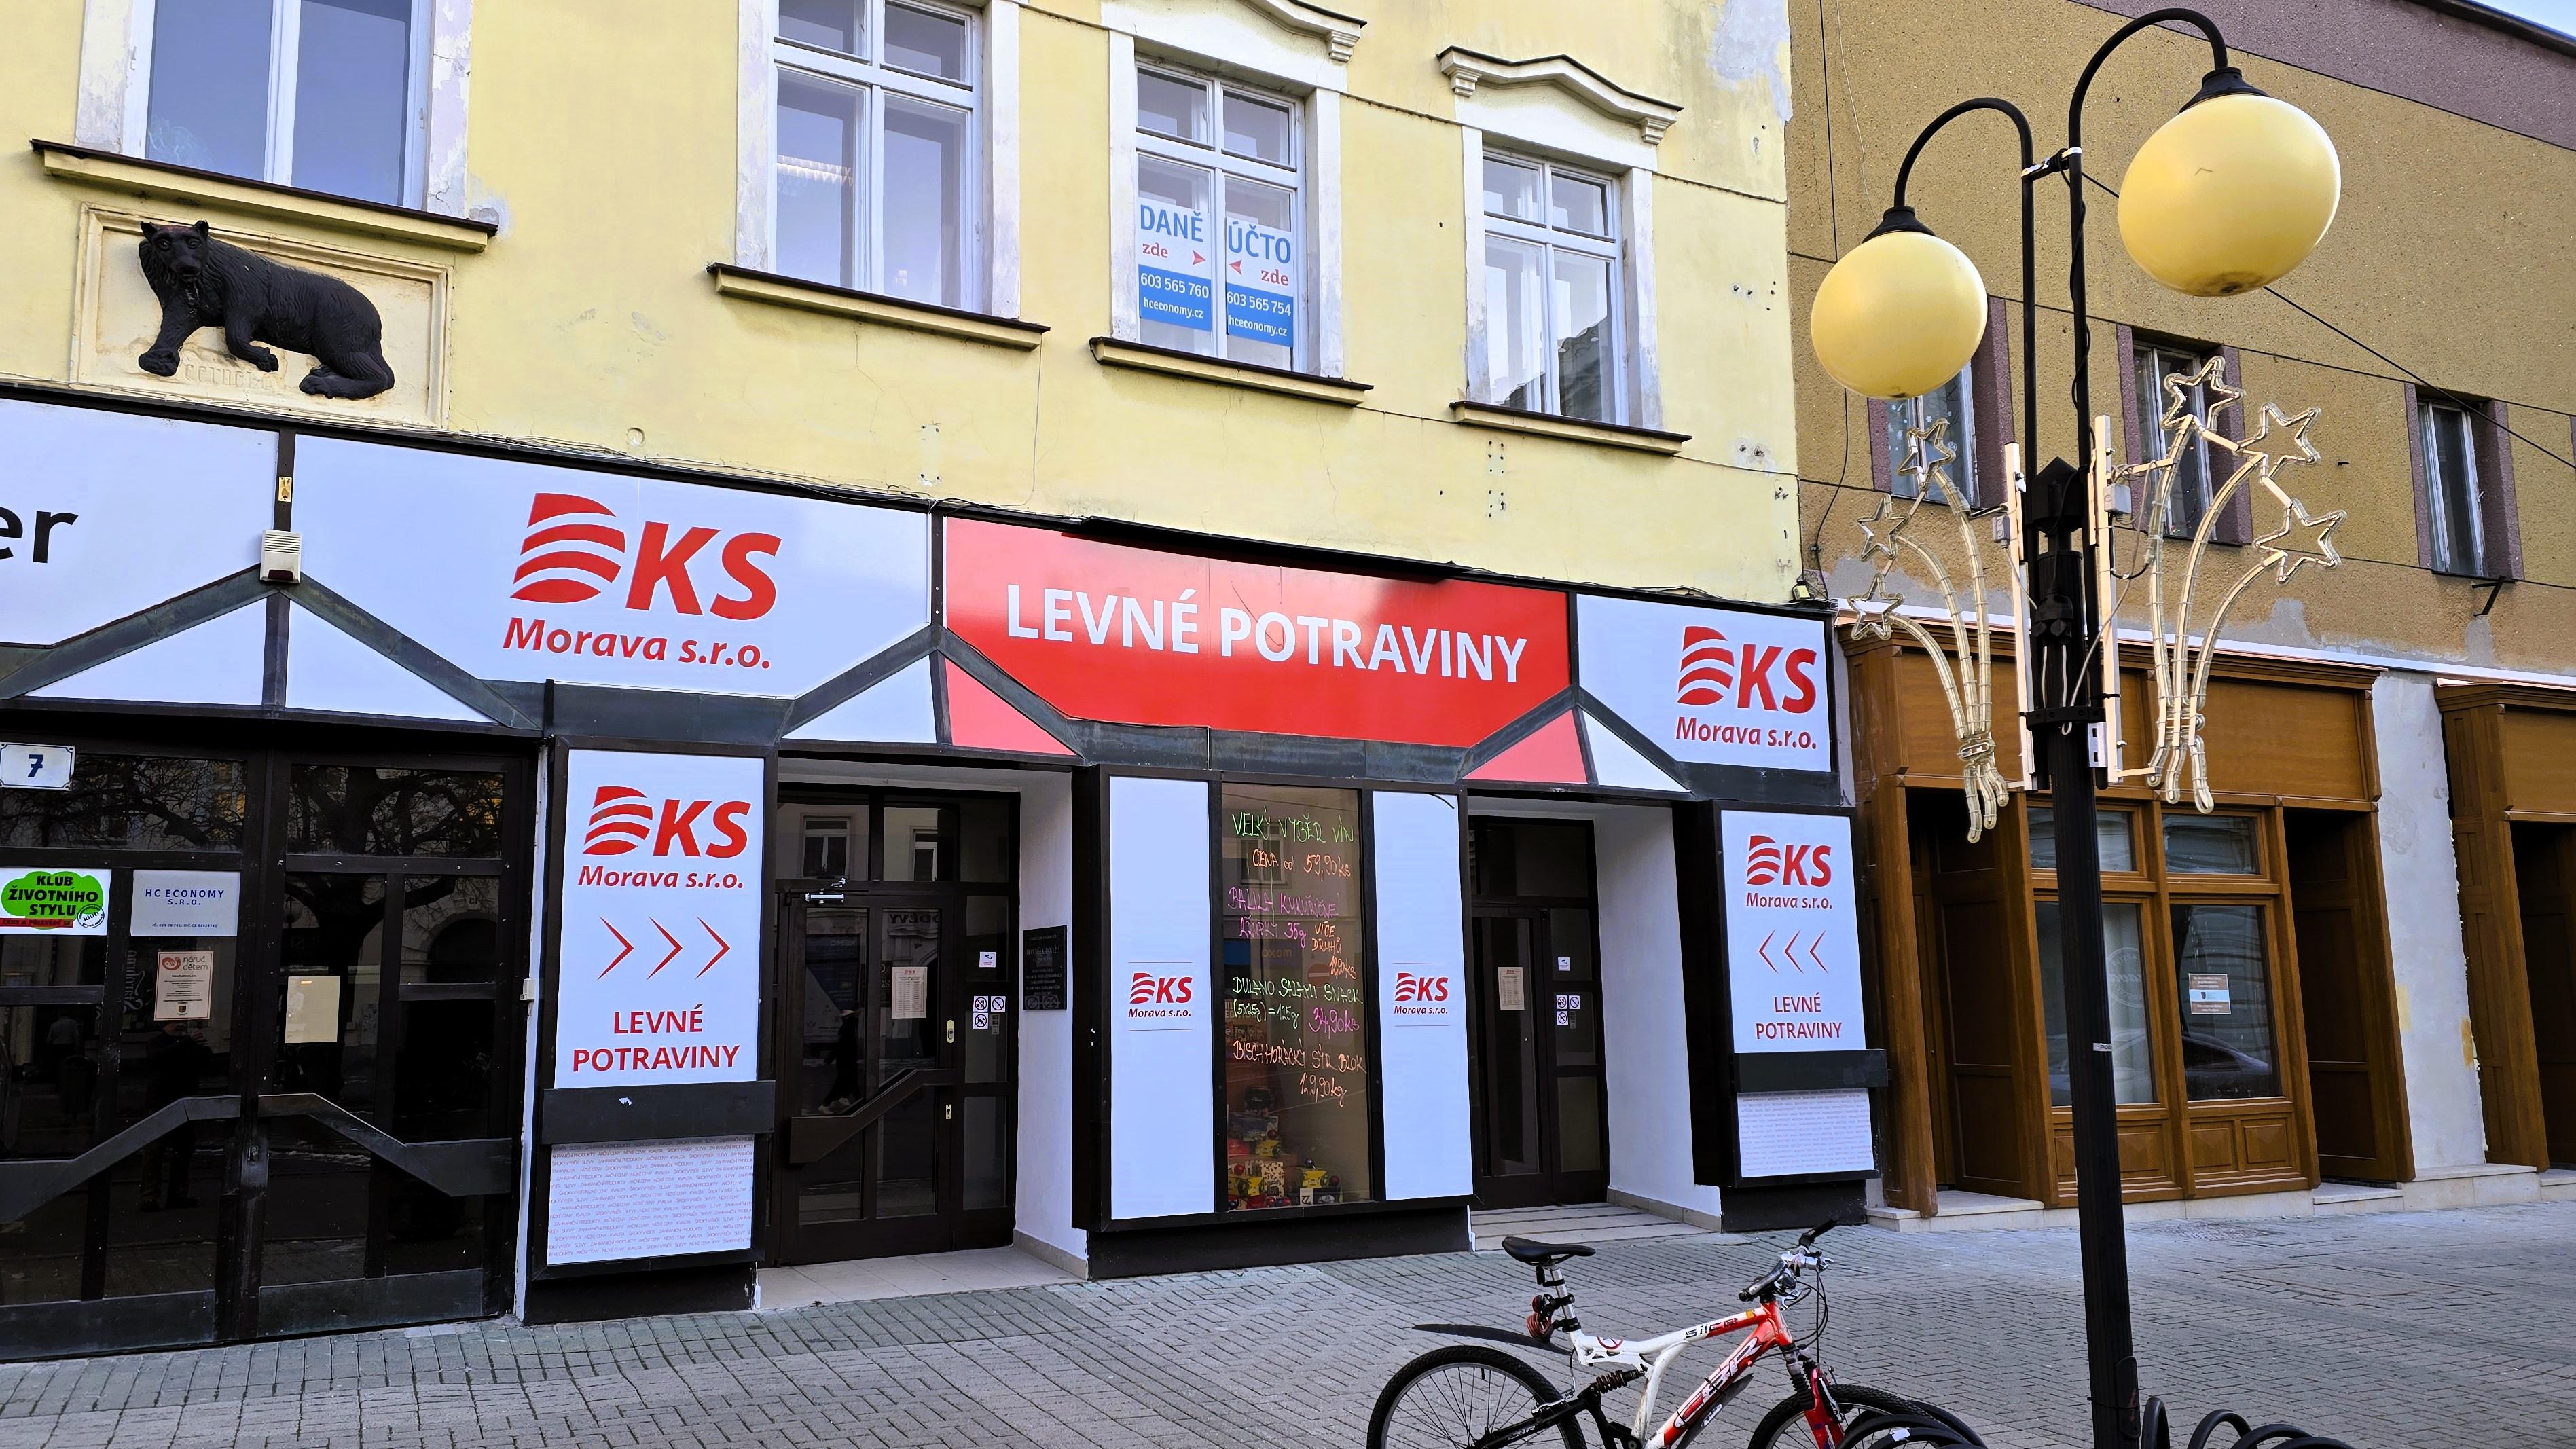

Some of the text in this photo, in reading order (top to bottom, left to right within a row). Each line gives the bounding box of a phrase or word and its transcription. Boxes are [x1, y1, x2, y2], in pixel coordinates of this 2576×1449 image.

[1140, 204, 1203, 243] DANĚ
[1142, 242, 1168, 258] zde
[1228, 221, 1291, 264] ÚČTO
[1140, 272, 1209, 298] 603 565 760
[1260, 269, 1289, 286] zde
[1143, 297, 1203, 318] hceconomy.cz
[1227, 291, 1291, 316] 603 565 754
[1229, 314, 1288, 337] hceconomy.cz
[503, 617, 771, 669] Morava s.r.o.
[1006, 585, 1527, 684] LEVNÉ POTRAVINY
[1675, 716, 1817, 750] Morava s.r.o.
[27, 754, 44, 778] 7
[36, 875, 73, 887] KLUB
[577, 865, 744, 889] Morava s.r.o.
[8, 885, 98, 902] ŽIVOTNÍHO
[145, 889, 225, 898] HC ECONOMY
[1745, 892, 1833, 910] Morava s.r.o.
[29, 904, 77, 916] STYLU
[1128, 1008, 1166, 1018] Morava
[1394, 1005, 1426, 1014] Morava
[1774, 992, 1821, 1013] LEVNÉ
[613, 1004, 704, 1034] LEVNÉ
[1756, 1022, 1843, 1040] POTRAVINY
[573, 1045, 740, 1072] POTRAVINY
[1674, 1337, 1766, 1428] CBR
